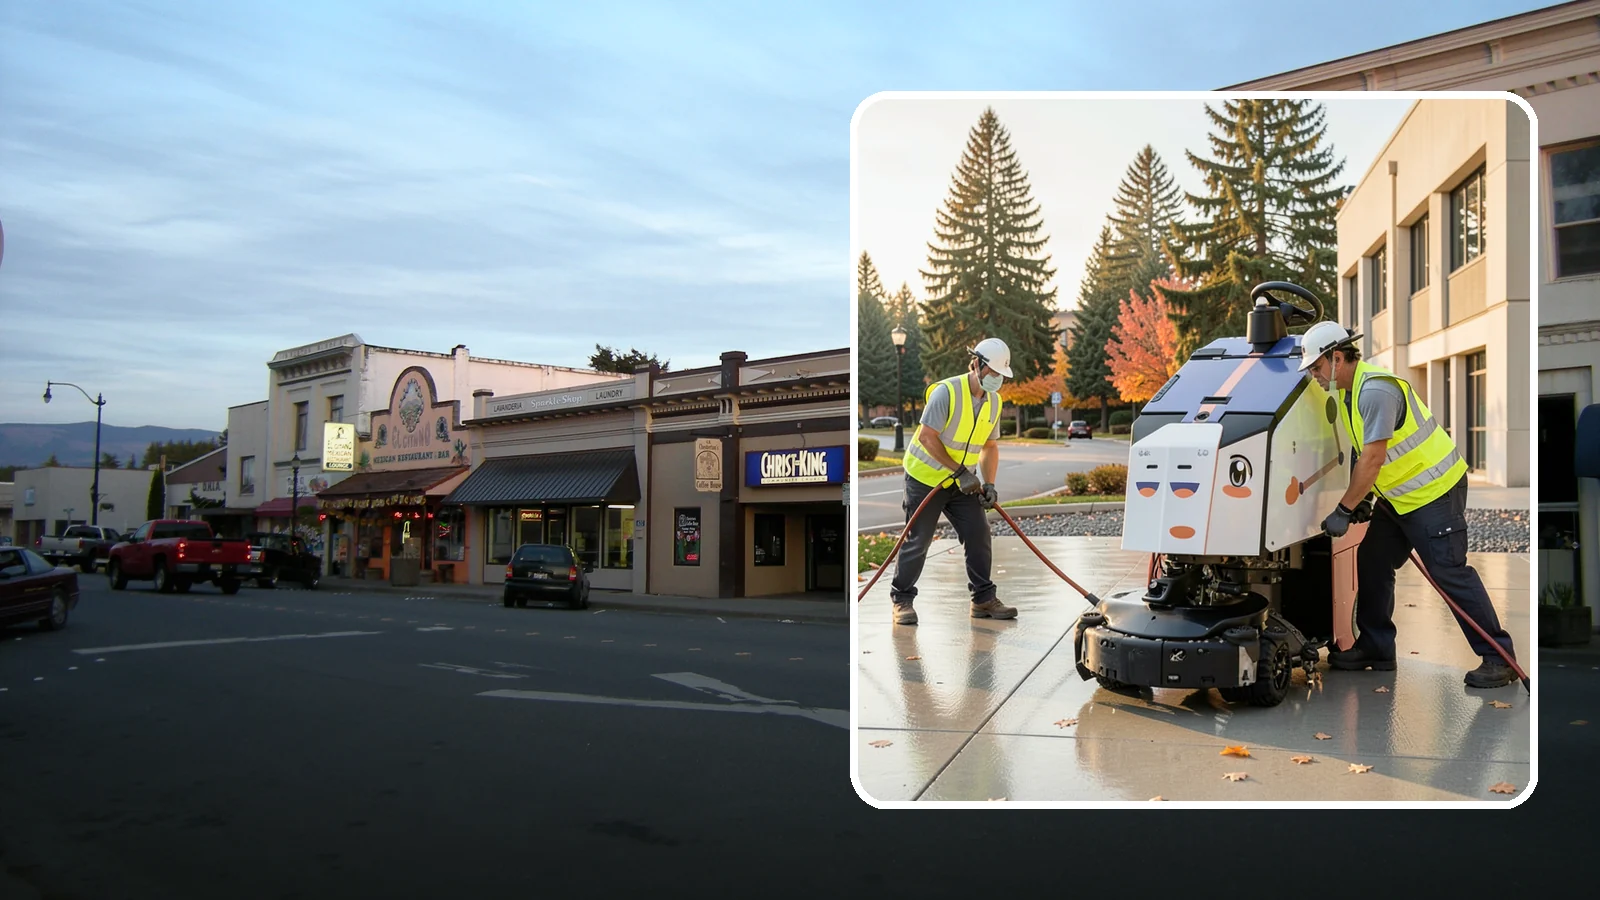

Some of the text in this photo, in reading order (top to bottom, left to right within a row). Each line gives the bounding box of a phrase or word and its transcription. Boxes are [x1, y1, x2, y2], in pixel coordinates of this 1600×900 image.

[493, 388, 624, 413] LAVANDERIA Sparkle Shop LAUNDRY
[373, 450, 450, 464] MEXICAN RESTAURANT BAR
[697, 480, 722, 489] Coffee House
